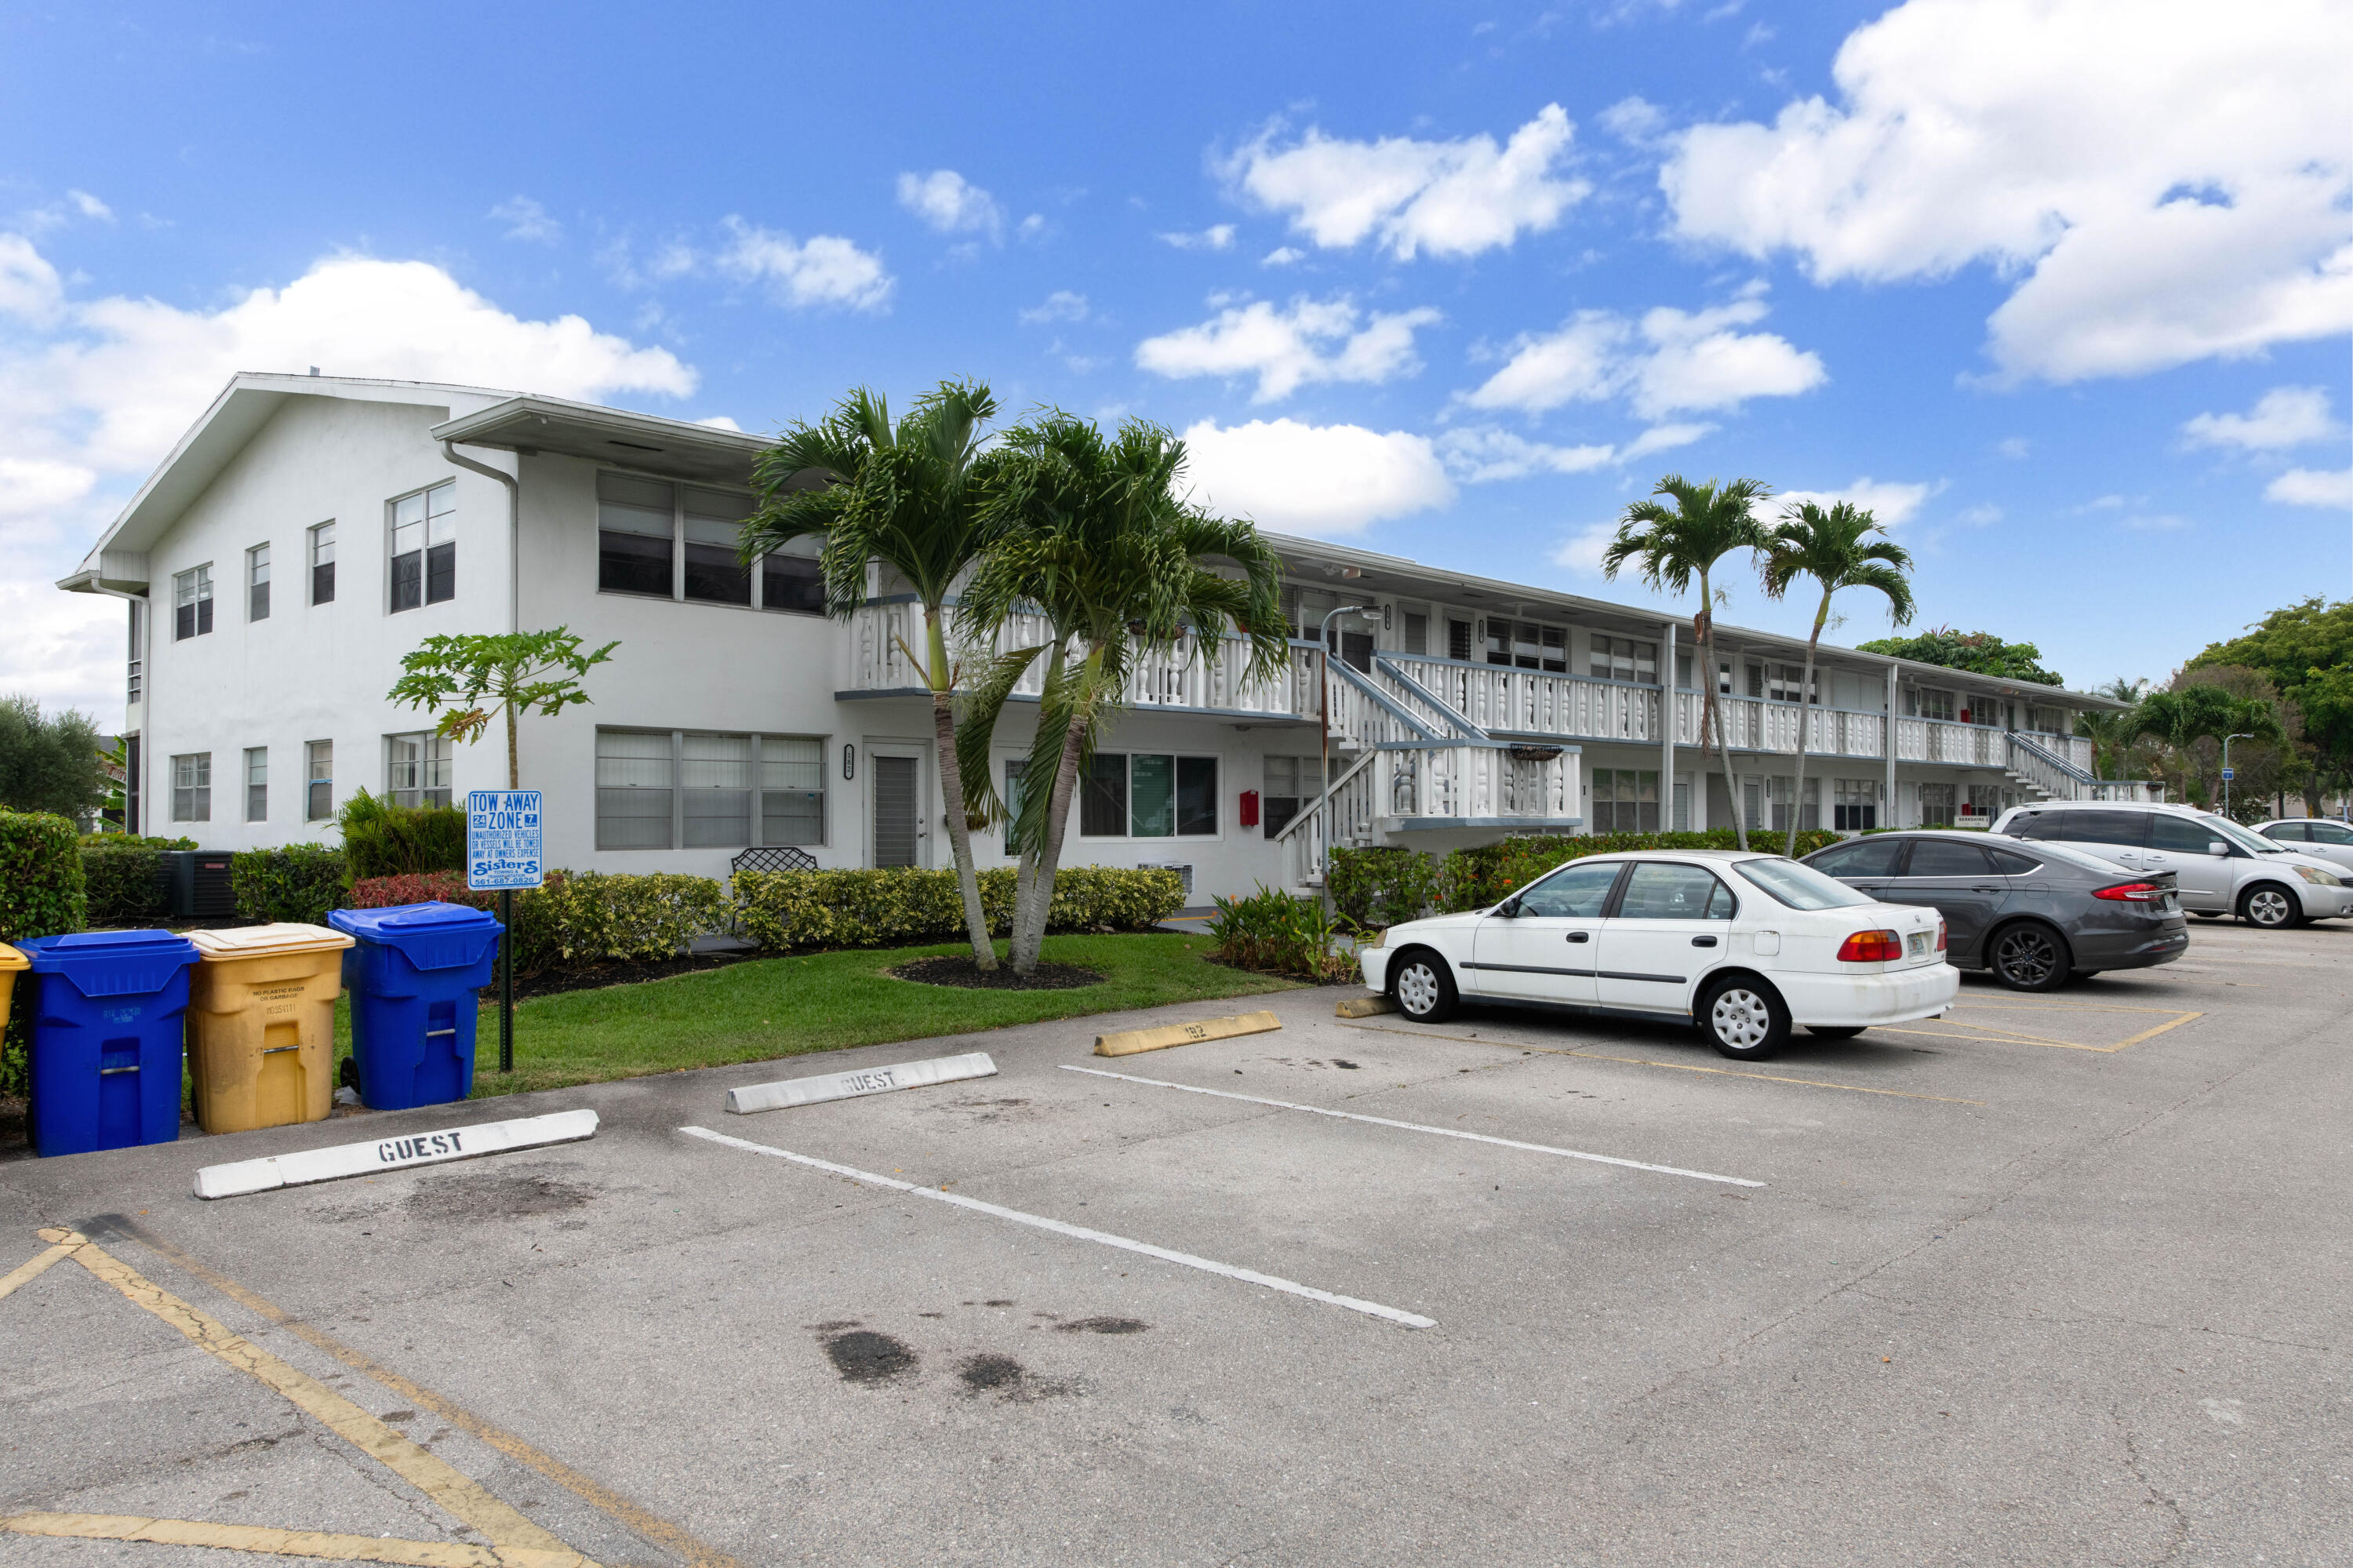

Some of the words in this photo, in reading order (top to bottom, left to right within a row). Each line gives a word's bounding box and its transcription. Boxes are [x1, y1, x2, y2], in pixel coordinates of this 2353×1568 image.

[472, 794, 498, 812] TOW
[505, 794, 539, 811] AWAY
[474, 814, 486, 824] 24
[489, 812, 523, 830] ZONE
[472, 830, 512, 840] UNAUTHORIZED
[514, 829, 539, 839] VEHICLES
[472, 840, 479, 849] OR
[481, 840, 501, 849] VESSELS
[503, 839, 514, 849] WILL
[515, 839, 522, 849] BE
[523, 839, 539, 848] TOWED
[472, 850, 485, 859] AWAY
[487, 849, 493, 859] AT
[495, 849, 515, 858] OWNERS
[517, 849, 539, 858] EXPENSE
[475, 877, 534, 886] 561-687-0820
[378, 1132, 463, 1162] GUEST
